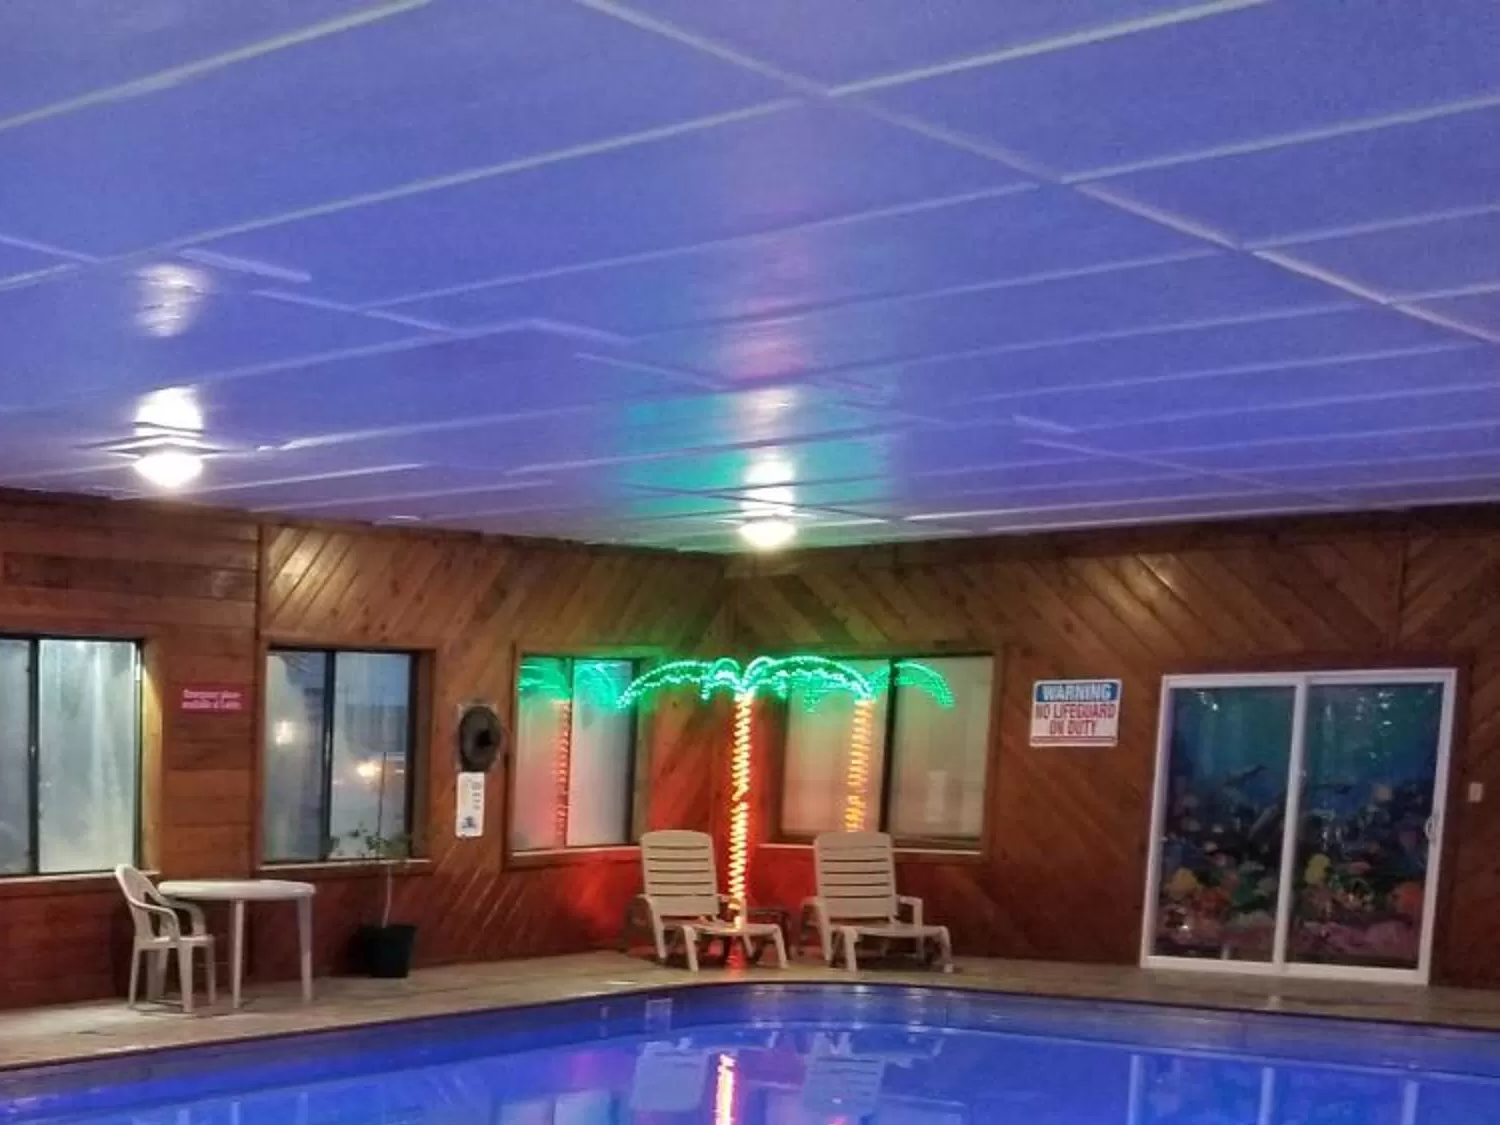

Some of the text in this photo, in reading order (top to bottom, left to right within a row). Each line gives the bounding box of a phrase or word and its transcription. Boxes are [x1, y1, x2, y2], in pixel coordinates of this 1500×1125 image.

[1042, 683, 1113, 701] WARNING
[1035, 703, 1115, 719] NO LIFEGUARD
[1049, 719, 1097, 735] ON DUTY
